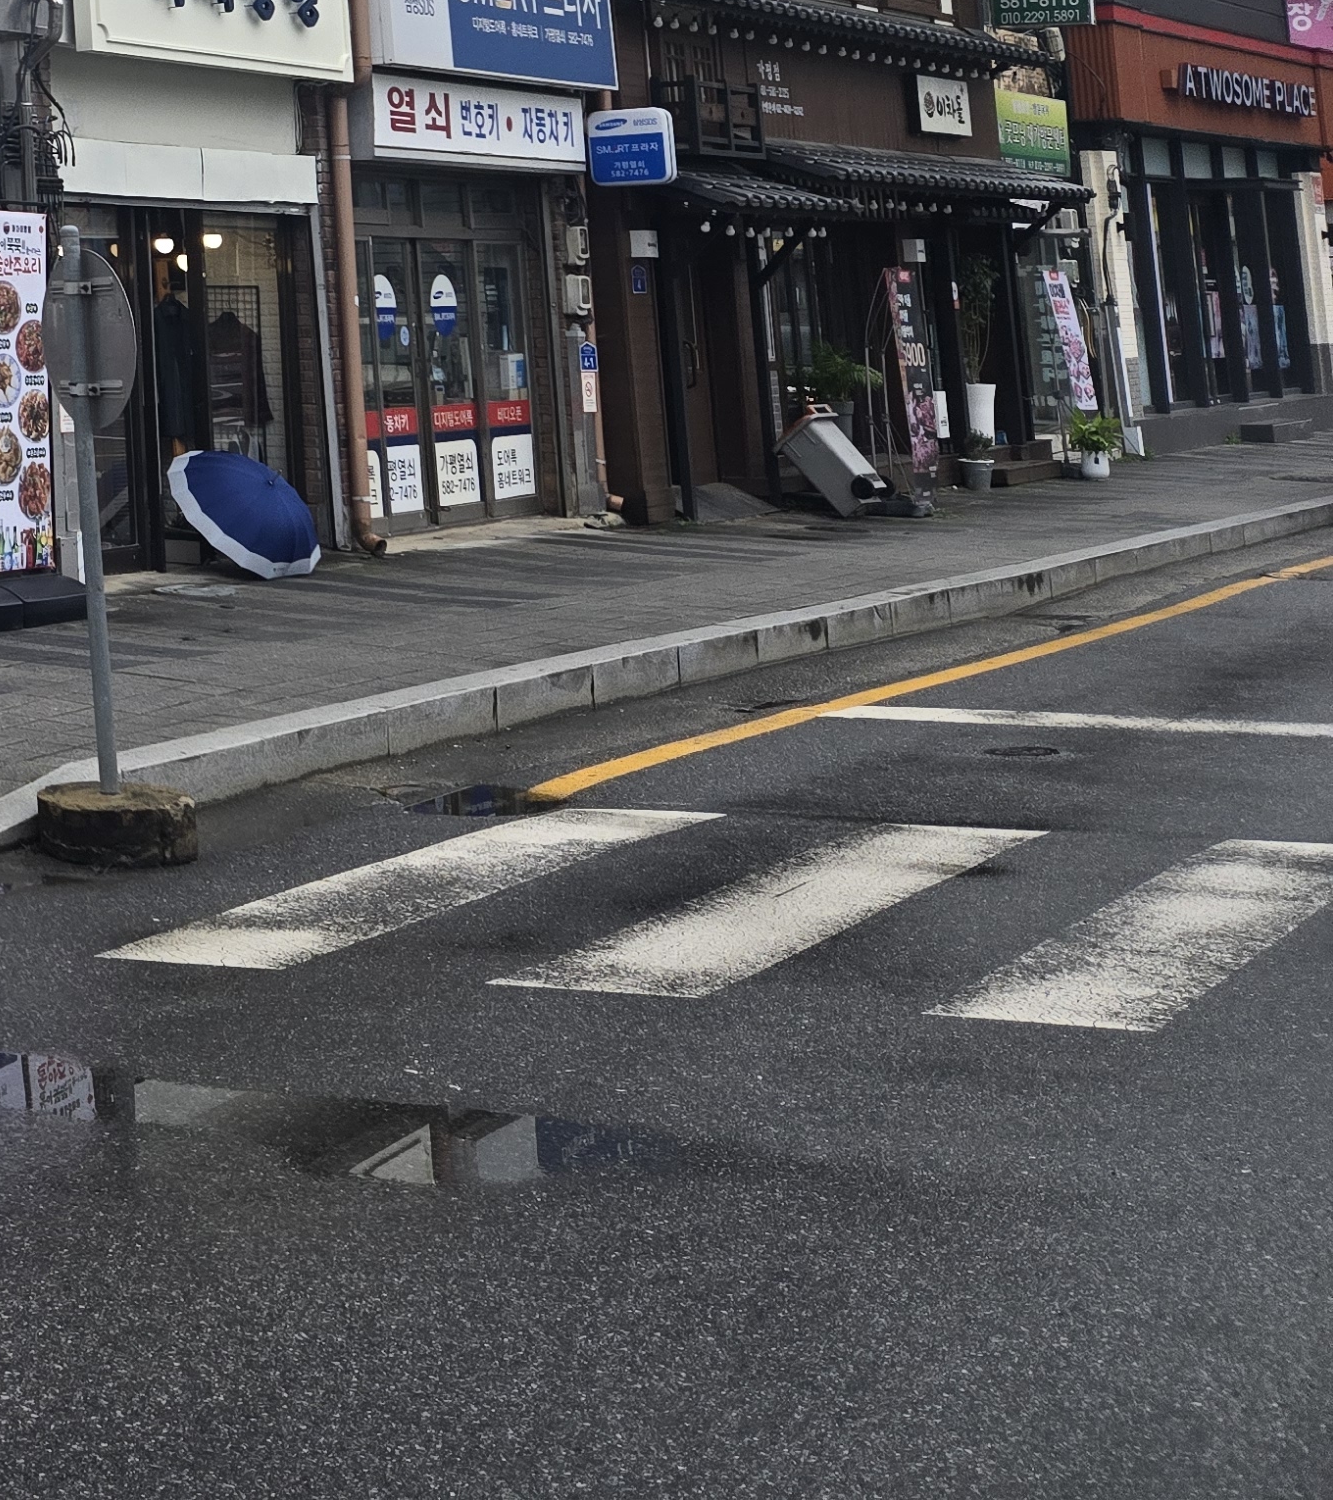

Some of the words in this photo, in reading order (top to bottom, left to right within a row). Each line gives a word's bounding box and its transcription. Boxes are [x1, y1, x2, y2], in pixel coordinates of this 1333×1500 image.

[1001, 9, 1080, 25] 010.2291.5891
[1185, 65, 1194, 97] A
[1197, 66, 1271, 110] TWOSOME
[1275, 80, 1317, 117] PLACE
[386, 86, 453, 140] 열쇠
[459, 100, 501, 142] 번호키
[521, 106, 575, 148] 자동차키
[631, 141, 659, 153] 프라자
[384, 414, 409, 434] 동차키
[433, 409, 474, 429] 디지털도어록
[439, 451, 474, 476] 가평열쇠
[497, 448, 518, 467] 도어록
[387, 457, 416, 483] 평열쇠
[497, 468, 532, 490] 홈네트워크
[390, 484, 419, 501] 2-7476
[441, 476, 476, 496] 582-7476
